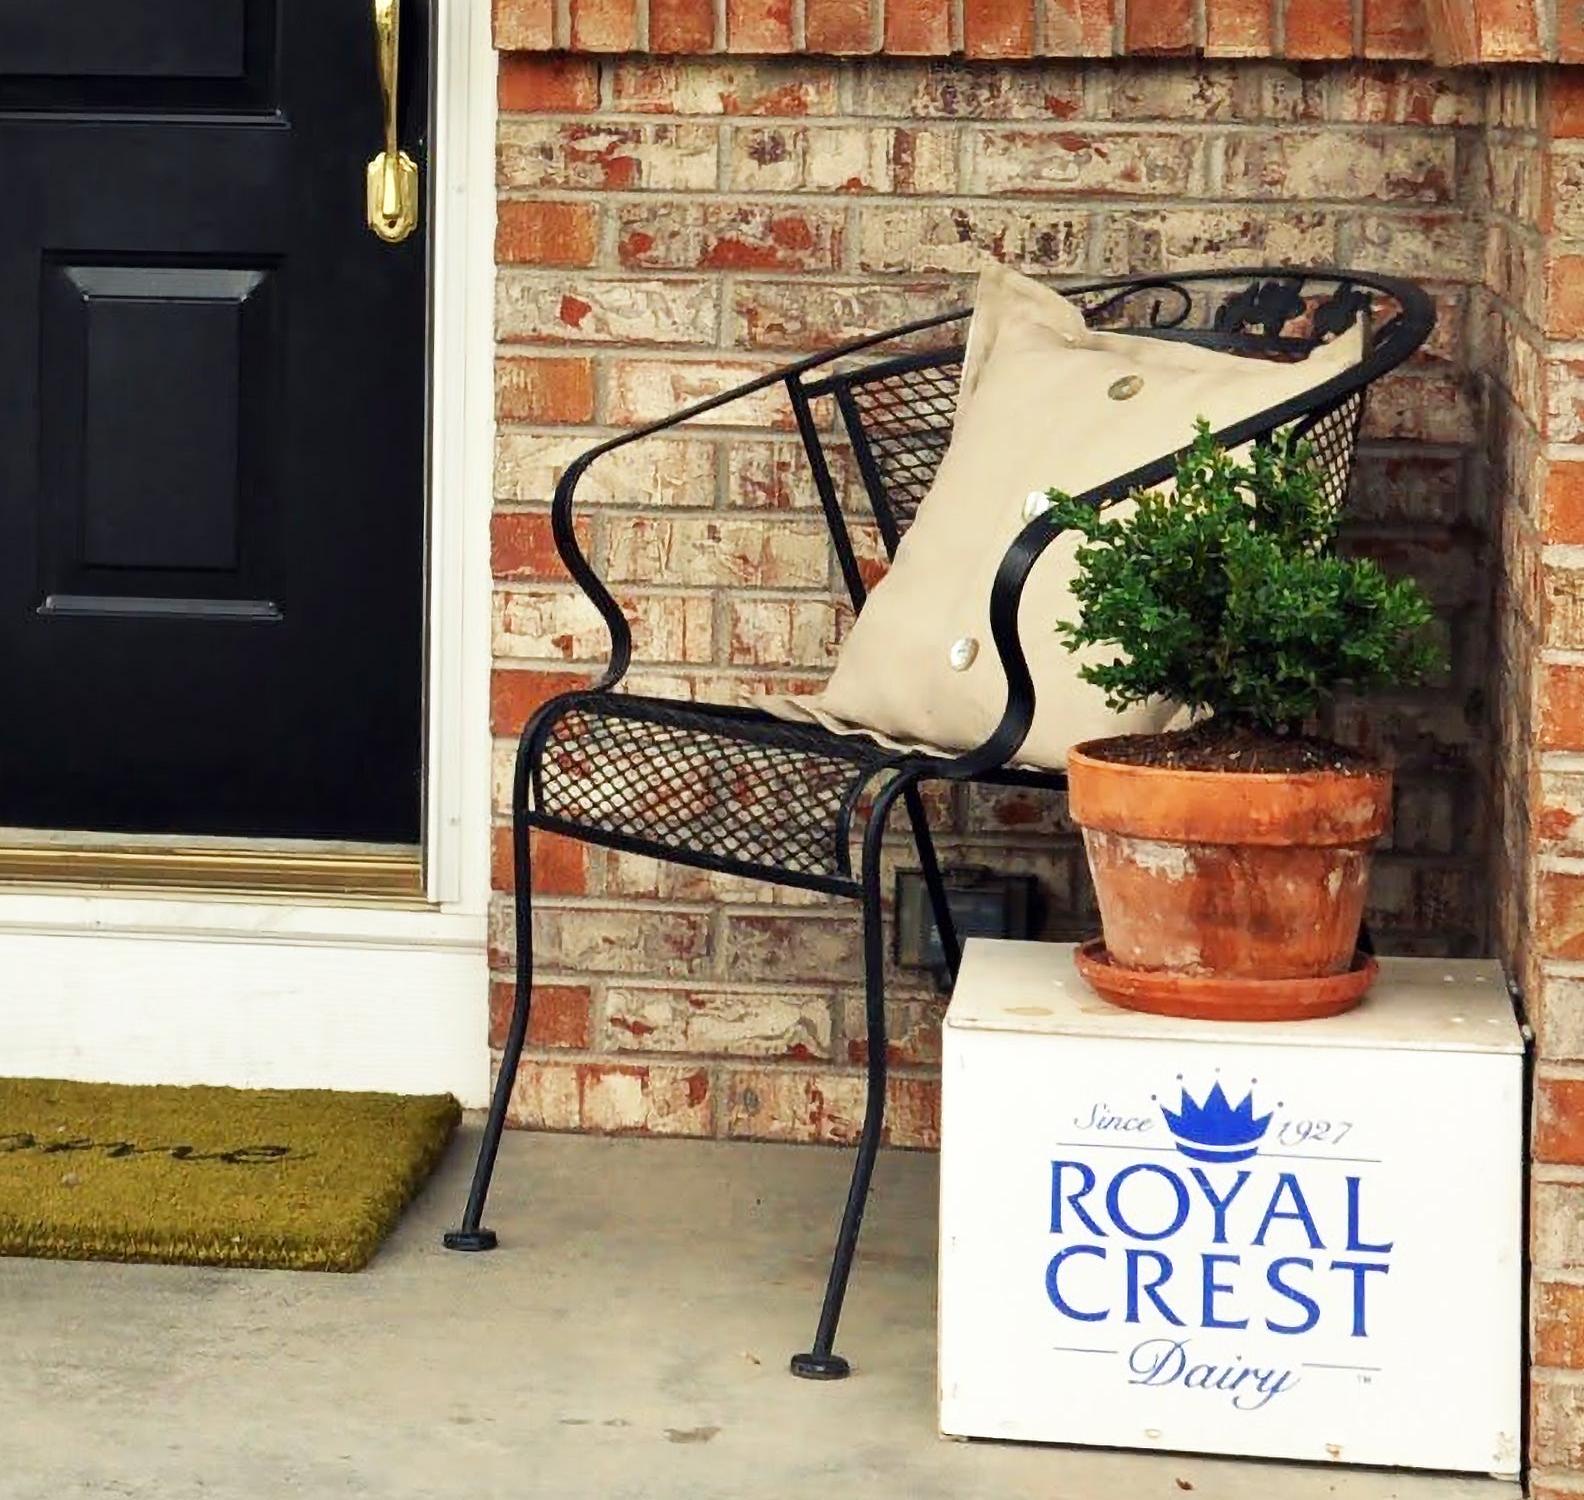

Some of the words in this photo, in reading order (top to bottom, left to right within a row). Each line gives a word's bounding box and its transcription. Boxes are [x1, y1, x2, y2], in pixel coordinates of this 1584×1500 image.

[1073, 1102, 1155, 1133] Since
[1277, 1120, 1353, 1146] 1927
[1049, 1160, 1394, 1253] ROYAL
[1044, 1244, 1390, 1338] CREST
[1127, 1338, 1301, 1411] Dairy
